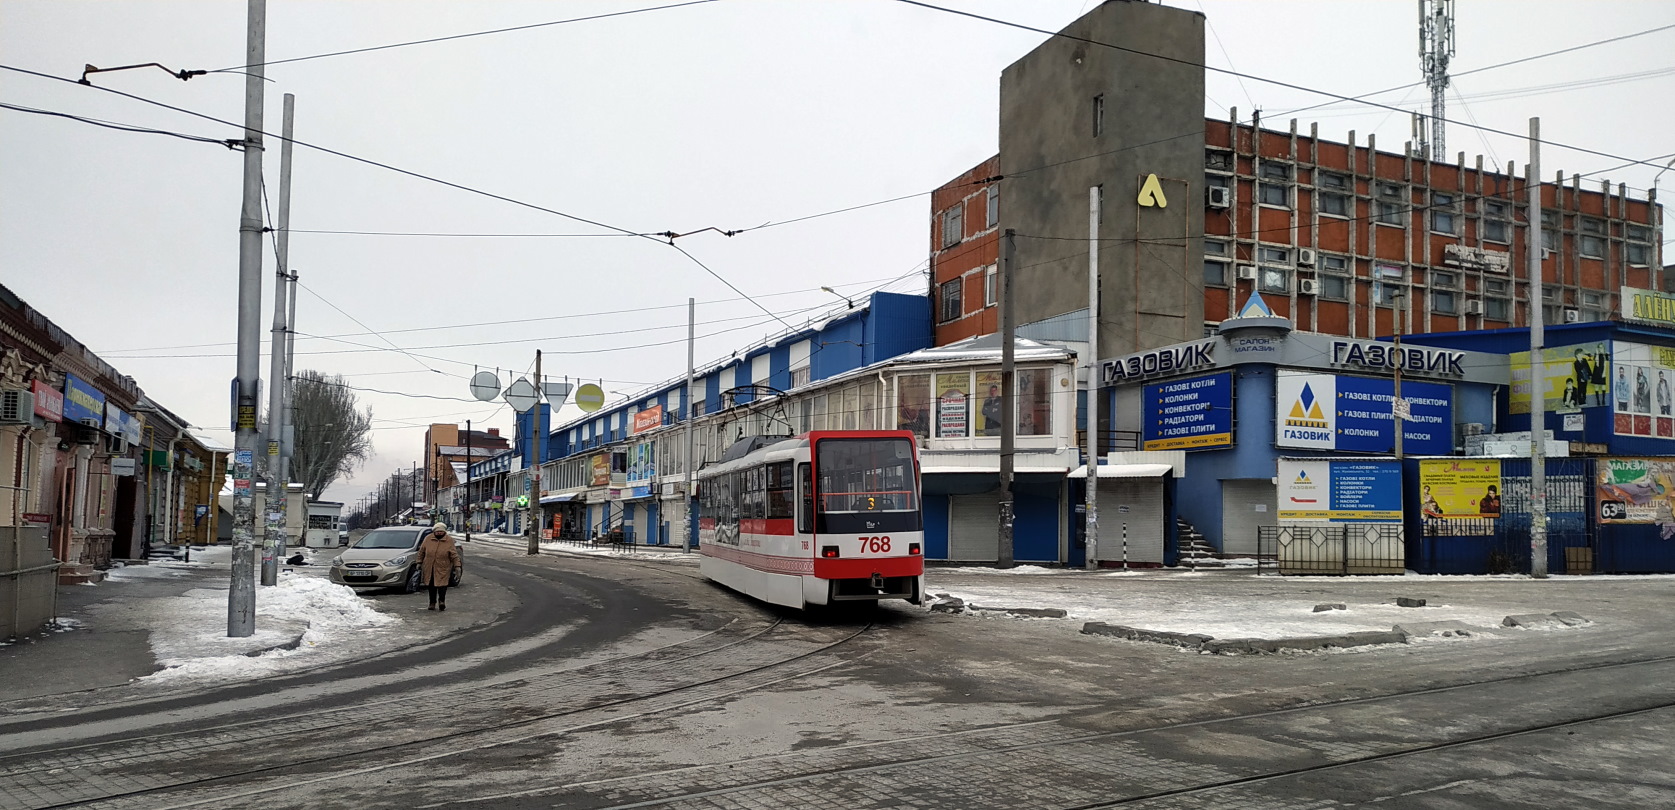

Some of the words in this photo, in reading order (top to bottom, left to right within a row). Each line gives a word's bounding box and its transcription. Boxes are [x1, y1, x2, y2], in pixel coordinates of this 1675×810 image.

[1240, 338, 1270, 346] САЛОН
[1235, 345, 1275, 353] МАГАЗИН
[1102, 341, 1216, 381] ГАЗОВИК
[1333, 341, 1465, 375] ГАЗОВИК
[1165, 384, 1190, 393] ГАЗОВІ
[1191, 379, 1216, 389] КОТЛИ
[1164, 393, 1199, 403] КОЛОНКИ
[1344, 392, 1371, 401] ГАЗОВІ
[1372, 394, 1396, 403] КОТЛИ
[1404, 397, 1448, 406] КОНВЕКТОРИ
[1164, 414, 1205, 425] РАДІАТОРИ
[1344, 410, 1370, 419] ГАЗОВІ
[1371, 412, 1396, 420] ПЛИТИ
[1405, 414, 1443, 424] АДІАТОРИ
[1164, 427, 1190, 436] ГАЗОВІ
[1190, 424, 1216, 434] ПЛИТИ
[1344, 428, 1380, 437] КОЛОНКИ
[1284, 430, 1331, 442] ГАЗОВИК
[1404, 432, 1431, 441] НАСОСИ
[868, 498, 875, 510] 3
[1602, 503, 1618, 517] 63
[801, 540, 809, 550] 768
[858, 536, 892, 554] 768
